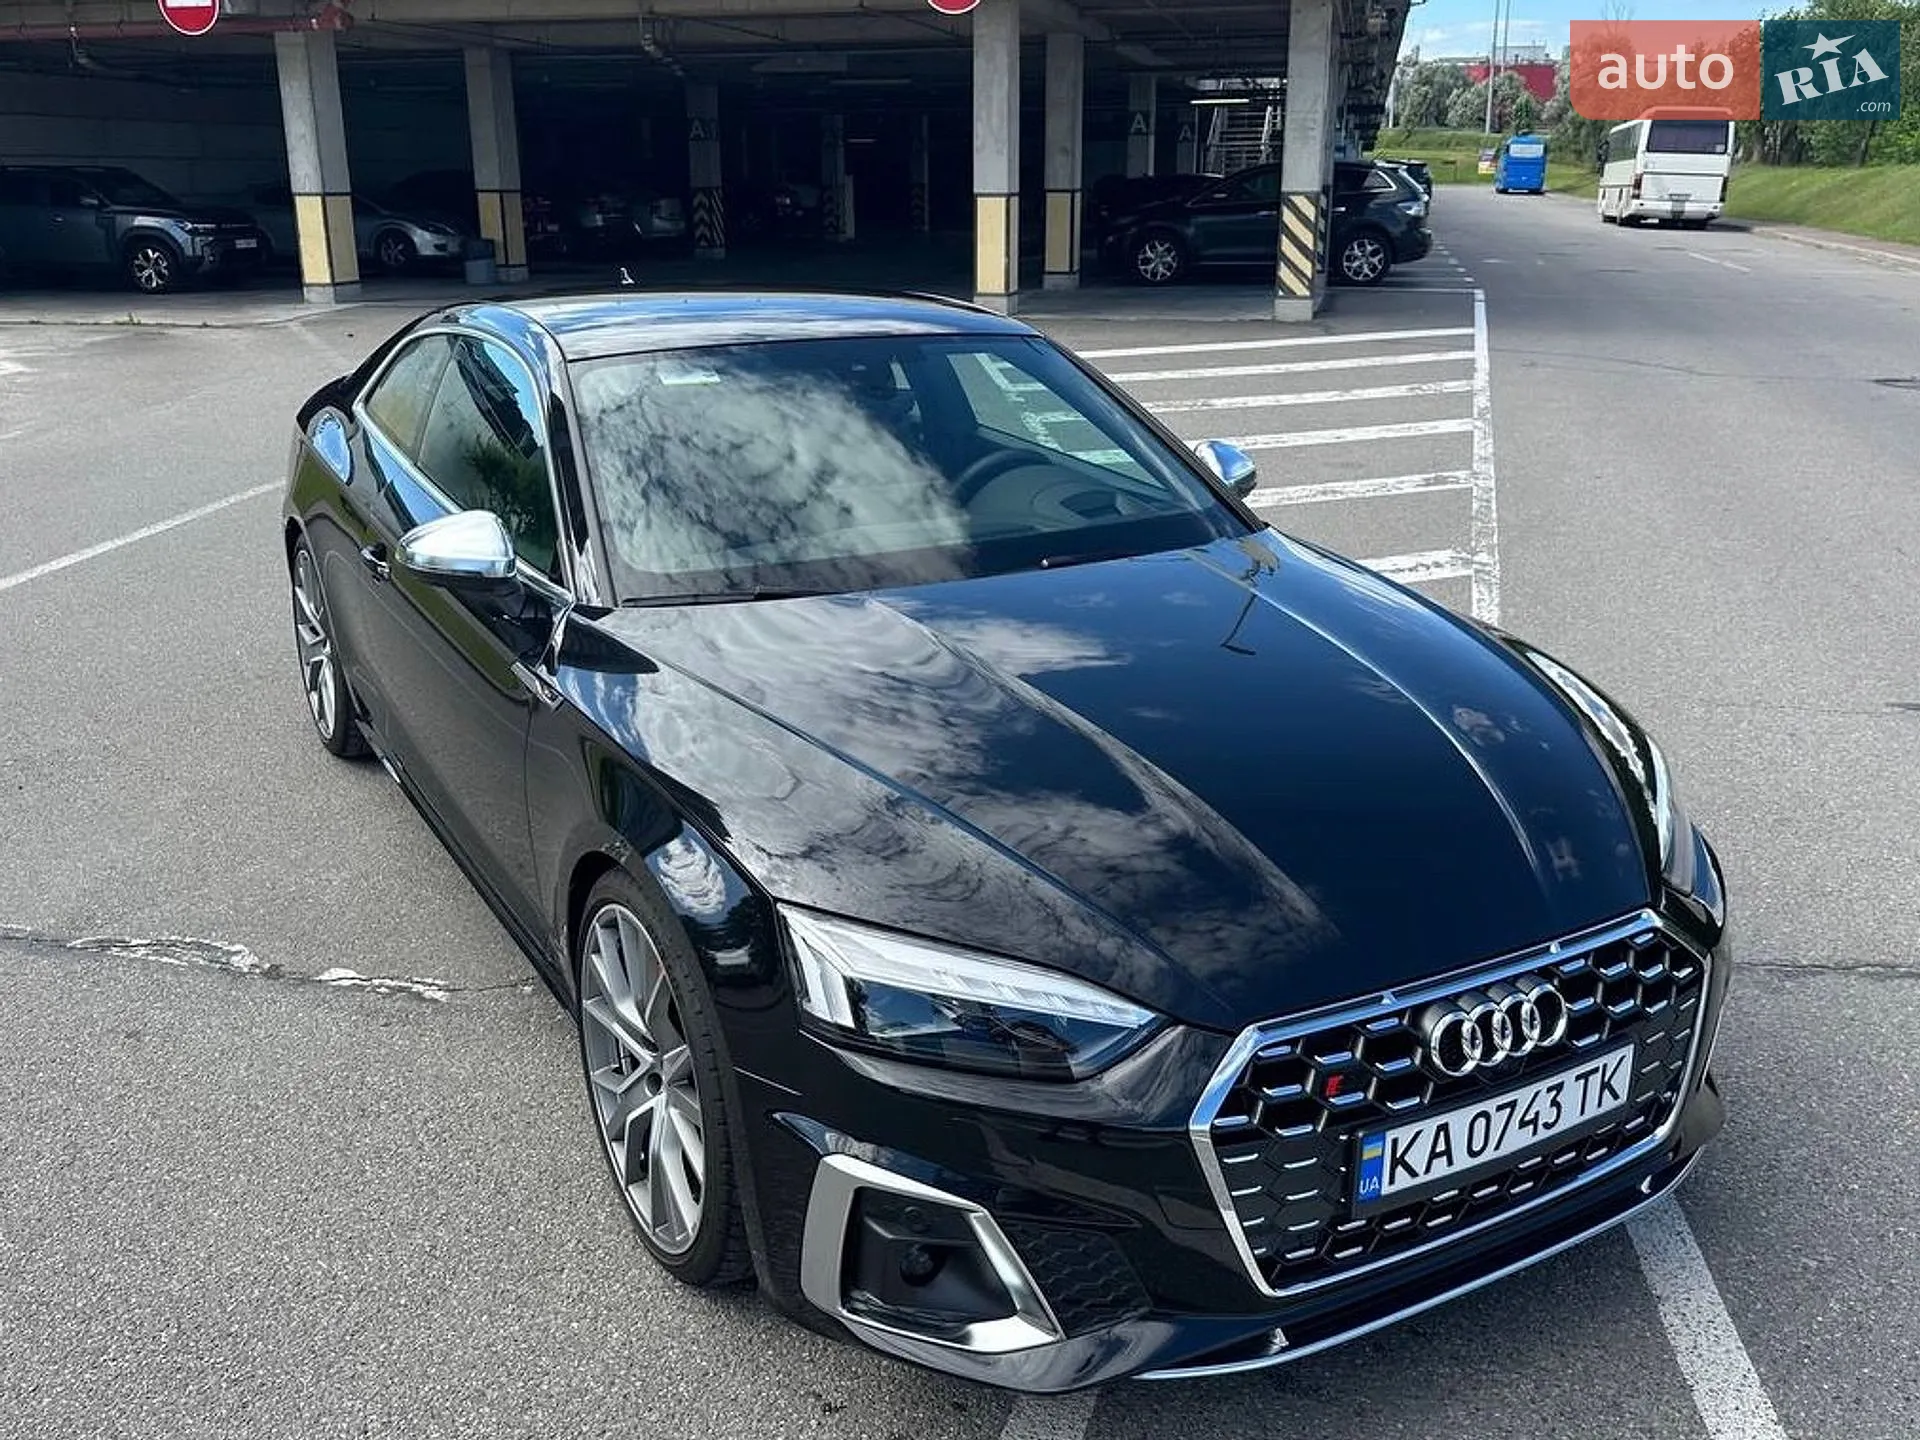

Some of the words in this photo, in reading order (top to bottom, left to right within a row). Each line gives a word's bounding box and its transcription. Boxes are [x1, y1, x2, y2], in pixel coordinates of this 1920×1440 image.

[1130, 111, 1147, 133] A
[1387, 1121, 1454, 1187] KA
[1465, 1080, 1565, 1160] 0743
[1575, 1055, 1627, 1117] TK
[1359, 1176, 1380, 1194] UA
